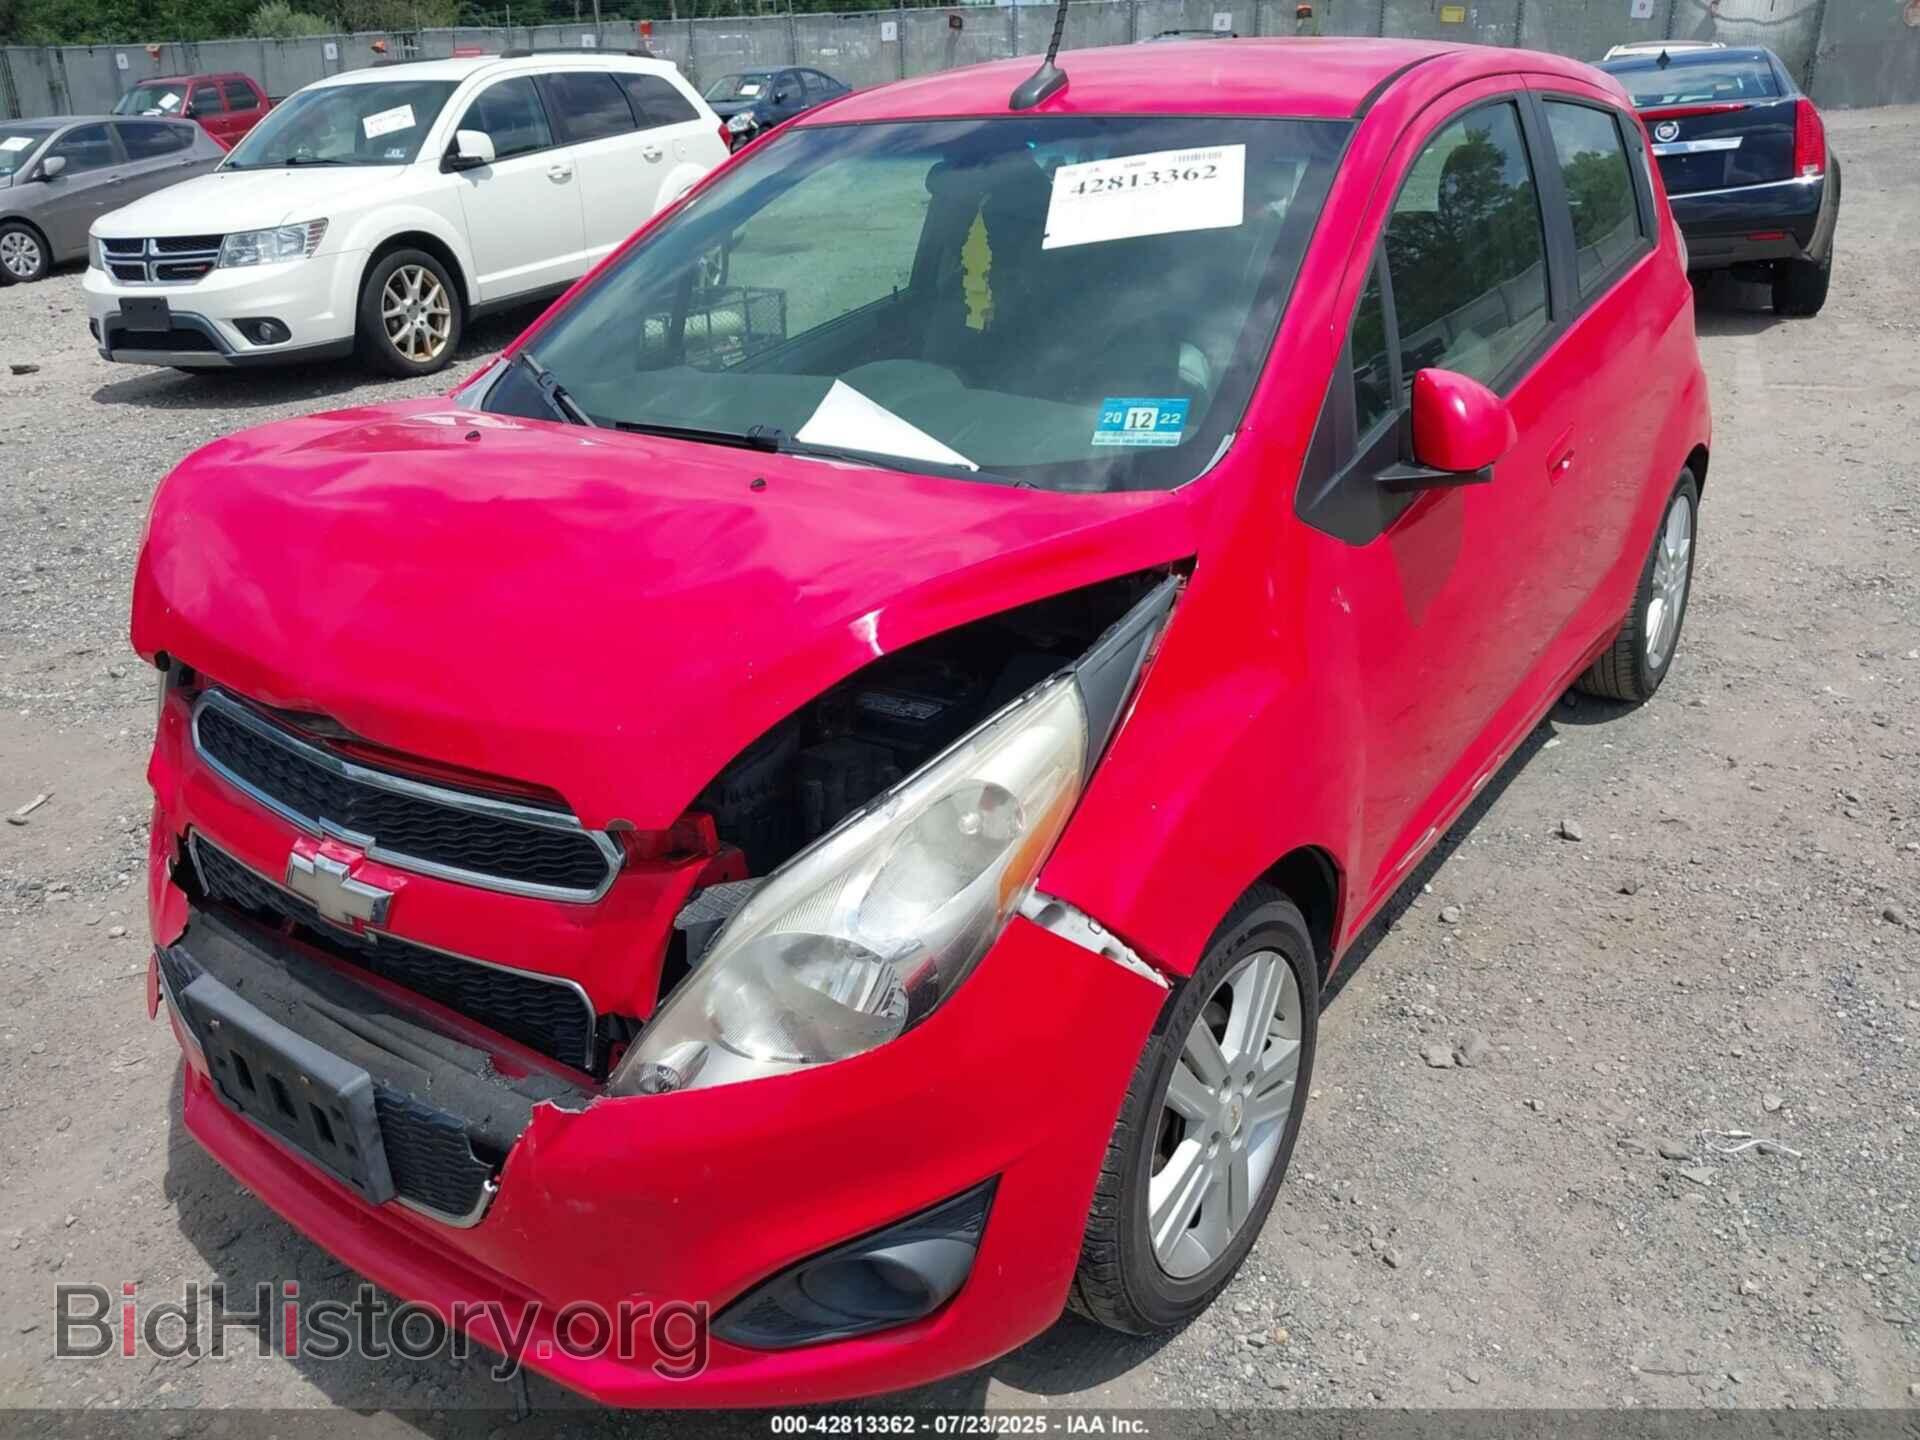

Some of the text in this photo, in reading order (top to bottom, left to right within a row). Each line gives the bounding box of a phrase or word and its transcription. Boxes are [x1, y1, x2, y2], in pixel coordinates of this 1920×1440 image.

[1070, 165, 1217, 195] 42813362
[1103, 411, 1182, 429] 20 12 22
